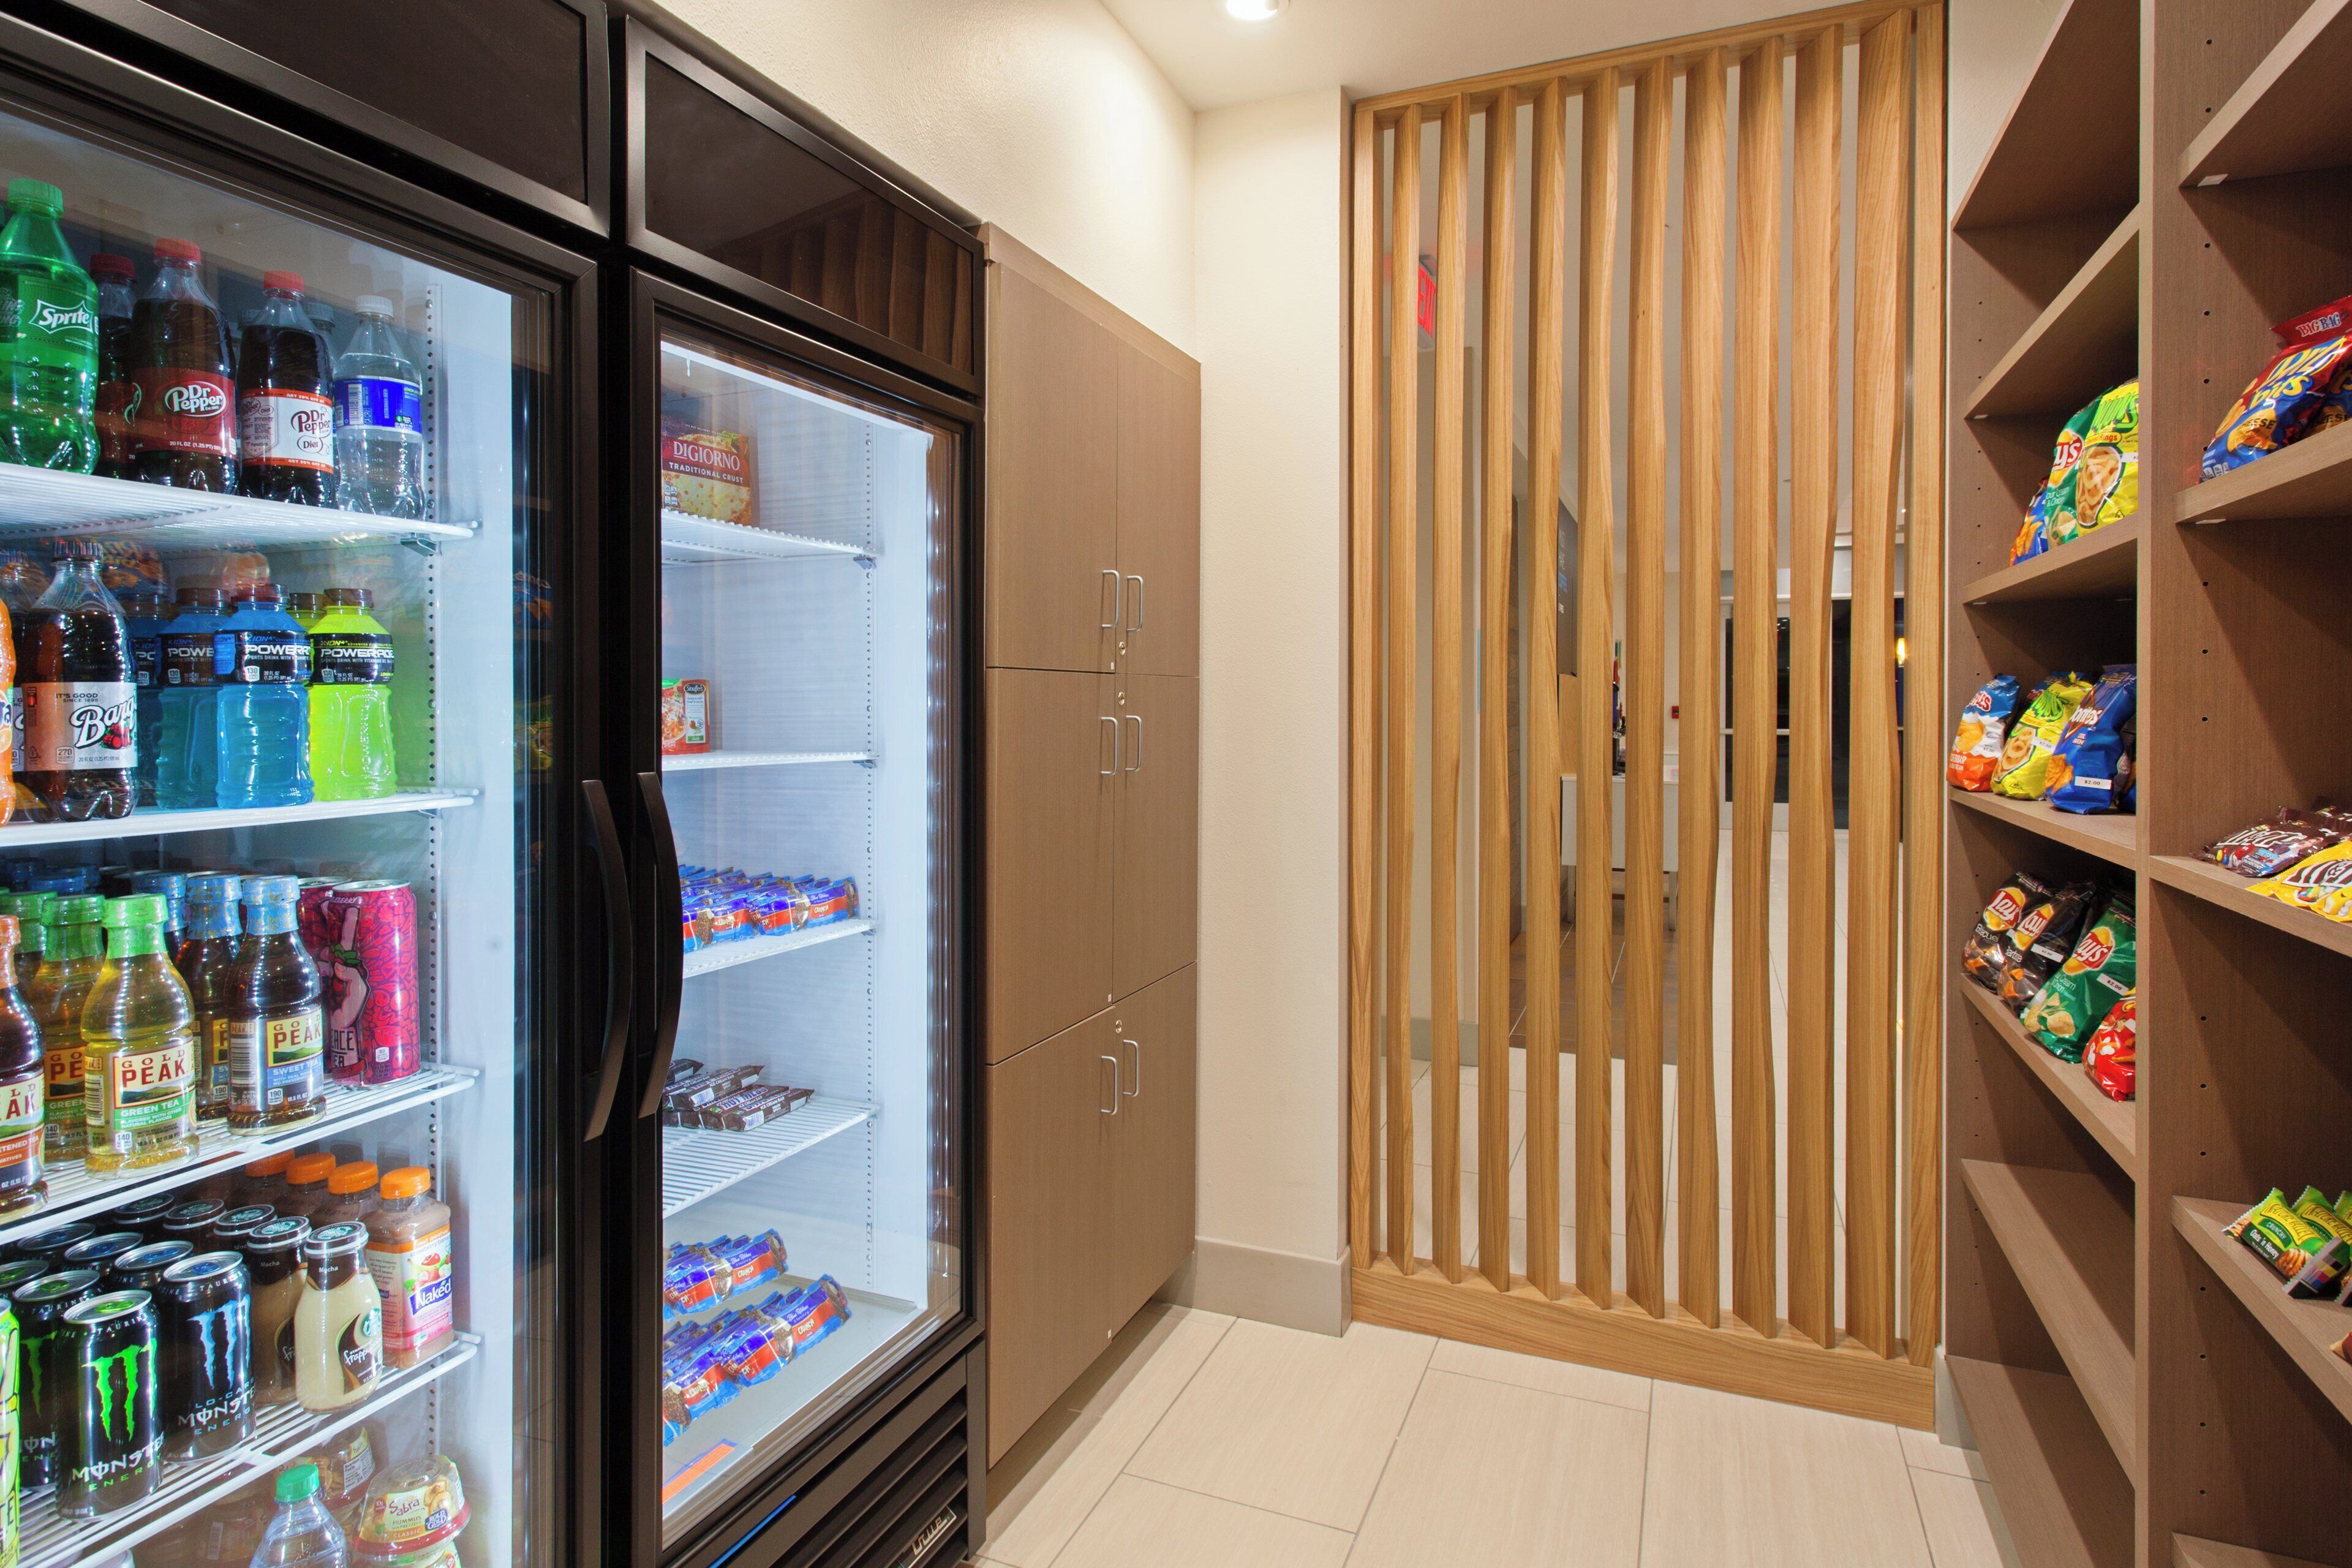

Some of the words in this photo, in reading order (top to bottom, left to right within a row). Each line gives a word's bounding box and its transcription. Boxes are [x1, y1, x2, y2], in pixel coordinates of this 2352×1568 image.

[38, 307, 89, 328] Sprite
[2297, 320, 2320, 337] BIG
[2319, 312, 2341, 331] BAG
[165, 387, 224, 413] Pepper
[188, 384, 211, 399] Dr
[290, 411, 331, 434] Pepper
[310, 410, 325, 421] Dr
[674, 440, 741, 472] DIGIORNO
[2053, 439, 2080, 470] y's
[669, 461, 721, 479] TRADITIONAL
[723, 473, 744, 484] CRUST
[167, 647, 214, 657] POWE
[69, 695, 135, 748] Barq
[814, 904, 829, 913] CRUNCH
[1987, 891, 2021, 922] Lay's
[2071, 932, 2109, 962] ay's
[2106, 979, 2122, 990] $2.00
[273, 1022, 321, 1049] PEAK
[334, 1030, 354, 1051] ACE
[50, 1051, 83, 1063] GO
[121, 1049, 185, 1069] GOLD
[332, 1054, 344, 1068] EA
[50, 1060, 83, 1081] PE
[121, 1058, 186, 1088] PEAK
[273, 1063, 304, 1076] SWEET
[11, 1083, 36, 1098] LD
[6, 1092, 36, 1120] AK
[121, 1105, 159, 1117] GREEN
[161, 1099, 180, 1111] TEA
[120, 1115, 151, 1125] FLAVORED
[167, 1107, 182, 1116] OTHER
[148, 1115, 173, 1125] FLAVORS
[29, 1134, 39, 1144] TEA
[2266, 1221, 2287, 1240] CRUNCHY
[2250, 1229, 2262, 1243] Oats
[2264, 1241, 2280, 1259] Honey
[737, 1265, 754, 1278] CRUNCH
[415, 1278, 451, 1310] Naked
[797, 1318, 815, 1335] CRUNCH
[178, 1385, 255, 1428] MONSTE
[194, 1406, 251, 1435] ENERG
[21, 1451, 56, 1462] ENE
[88, 1453, 162, 1492] ENERGY
[388, 1498, 420, 1516] Sabra
[393, 1515, 422, 1526] HUMMUS
[428, 1515, 447, 1530] GOLD
[393, 1529, 421, 1539] CLASSIC
